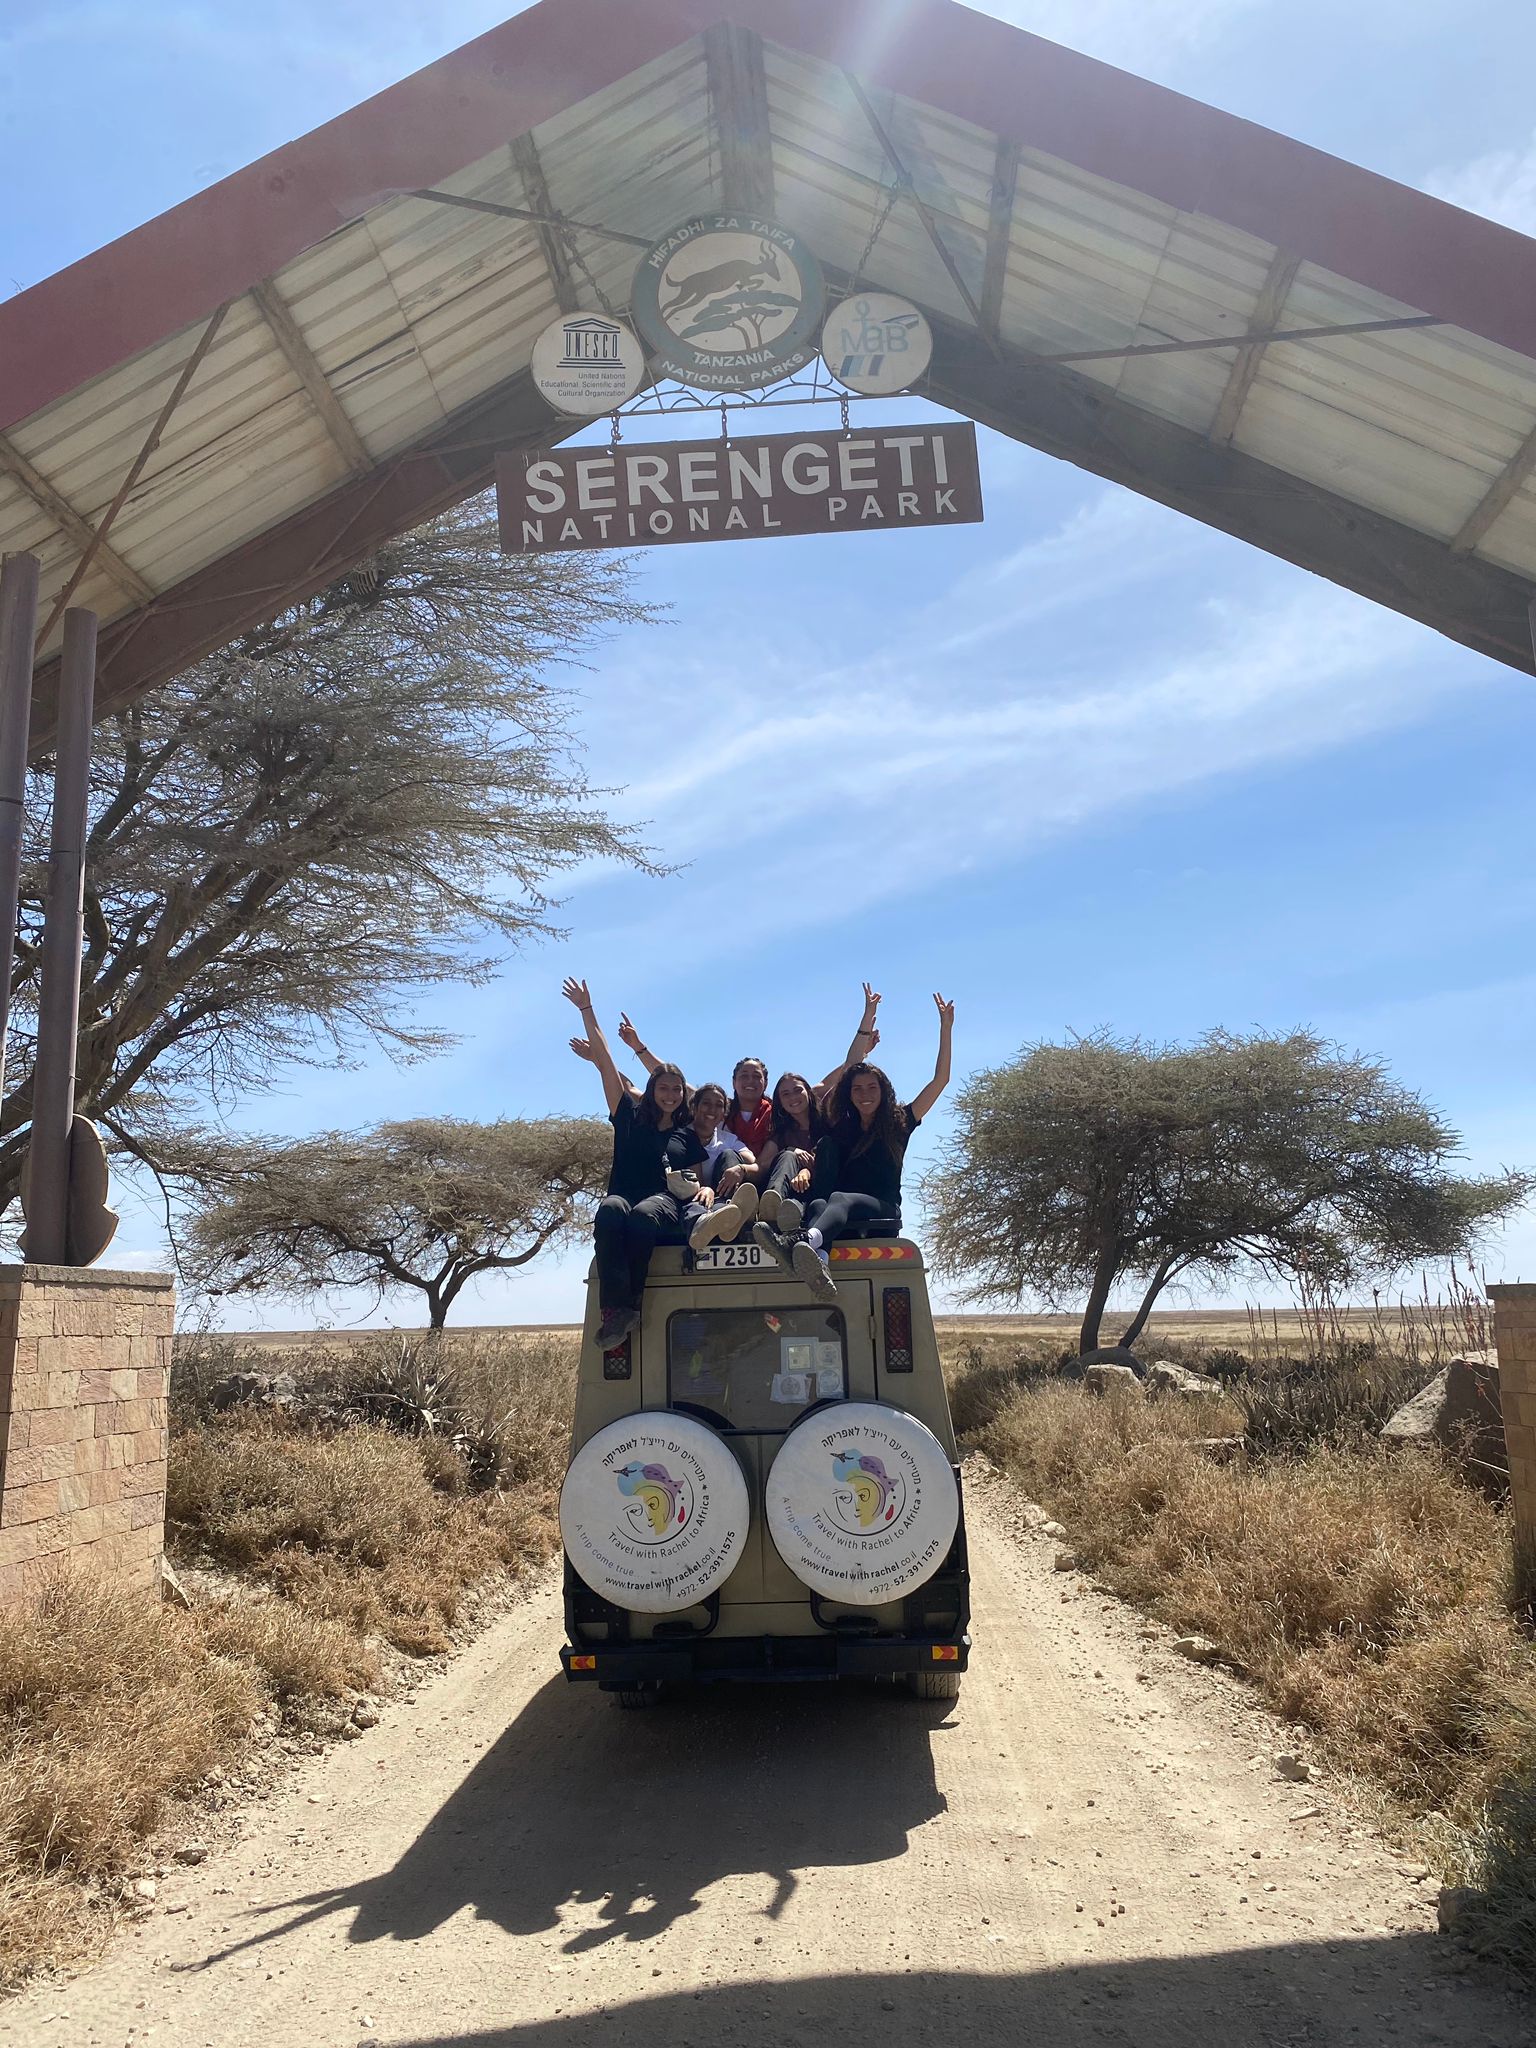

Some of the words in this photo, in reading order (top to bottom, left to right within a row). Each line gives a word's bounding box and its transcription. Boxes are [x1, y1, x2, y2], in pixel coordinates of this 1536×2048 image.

[648, 220, 705, 269] HIFADHI
[714, 217, 740, 229] ZA
[750, 219, 796, 251] TAIFA
[565, 332, 618, 358] UNESCO
[661, 360, 745, 385] NATIONAL
[751, 352, 805, 383] PARKS
[693, 349, 776, 368] TANZANIA
[557, 389, 584, 397] Cultural
[584, 389, 626, 398] Organization
[582, 380, 612, 388] Scientific
[613, 380, 626, 388] and
[525, 435, 949, 514] SERENGETI
[521, 503, 782, 545] NATIONAL
[828, 488, 958, 522] PARK
[709, 1247, 721, 1267] T
[724, 1246, 761, 1267] 230
[667, 1441, 681, 1453] עם
[821, 1426, 860, 1448] לאפריקה
[888, 1438, 902, 1450] עם
[602, 1438, 638, 1467] לאפריקה
[680, 1450, 706, 1482] מטיילים
[901, 1450, 922, 1485] מטיילים
[783, 1496, 791, 1504] A
[608, 1531, 635, 1555] Travel
[636, 1549, 658, 1559] with
[660, 1536, 691, 1558] Rachel
[688, 1527, 700, 1539] to
[695, 1494, 710, 1527] Africa
[784, 1505, 796, 1524] trip
[812, 1512, 837, 1541] Travel
[837, 1537, 858, 1550] with
[861, 1535, 894, 1551] Rachel
[893, 1528, 905, 1539] to
[903, 1498, 921, 1529] Africa
[575, 1523, 583, 1532] A
[579, 1532, 593, 1549] trip
[591, 1549, 614, 1569] come
[793, 1525, 813, 1548] come
